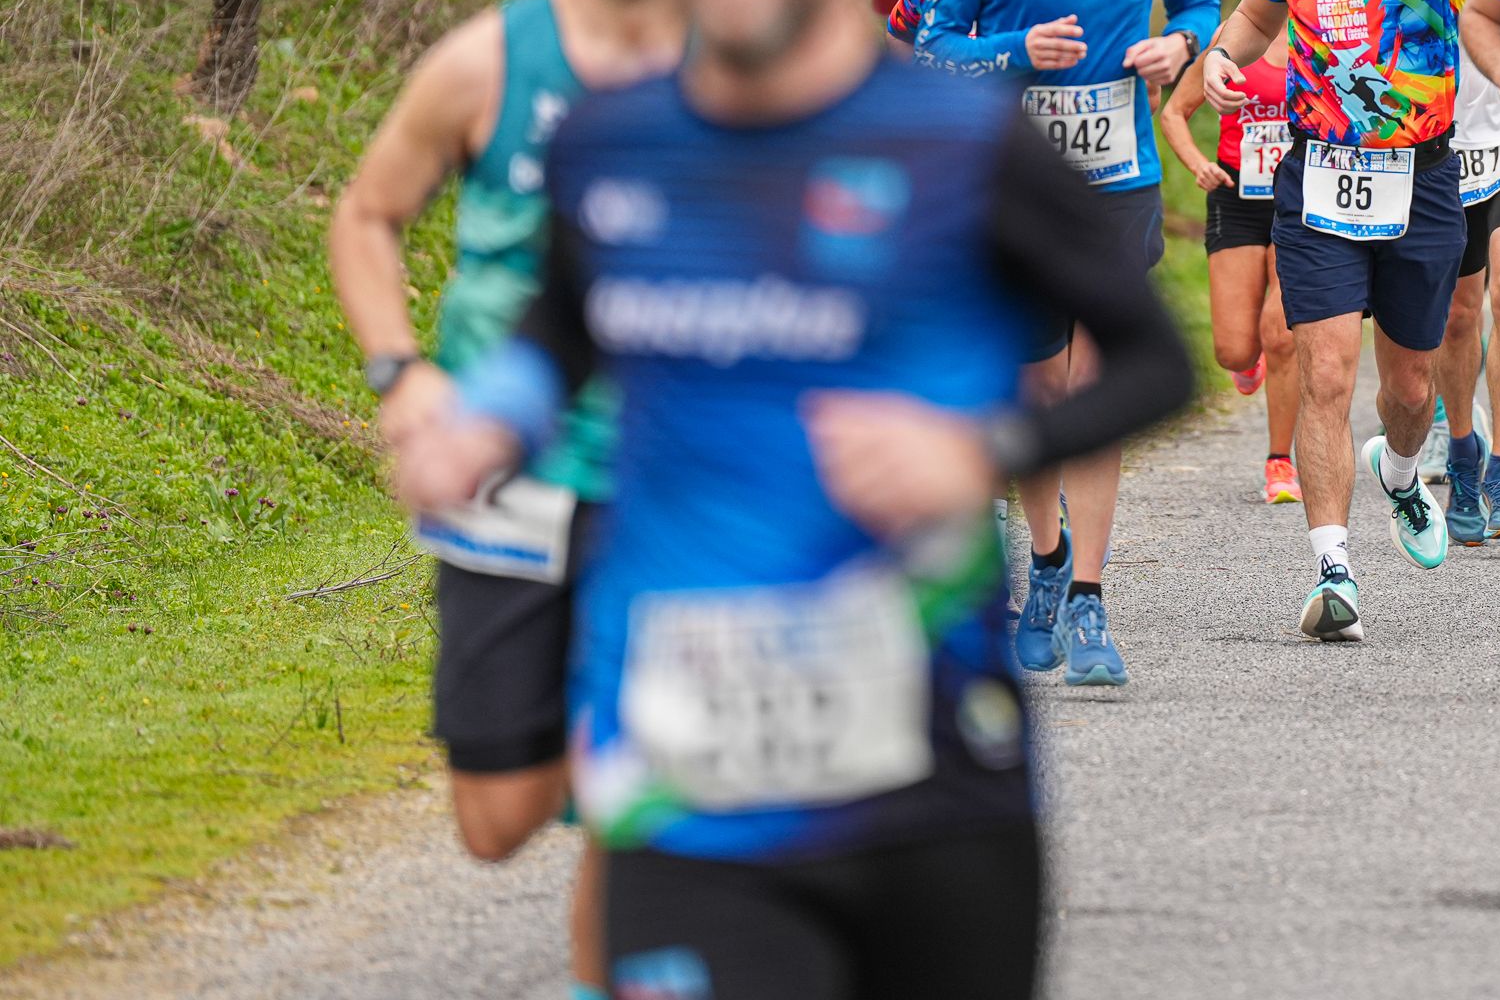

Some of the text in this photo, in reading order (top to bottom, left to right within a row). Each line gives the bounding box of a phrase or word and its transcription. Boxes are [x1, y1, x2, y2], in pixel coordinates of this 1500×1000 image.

[1317, 2, 1350, 17] MEDIA
[1318, 11, 1368, 30] MARATÓN
[1040, 90, 1077, 115] 21K
[1048, 117, 1111, 157] 942
[1336, 174, 1373, 211] 85
